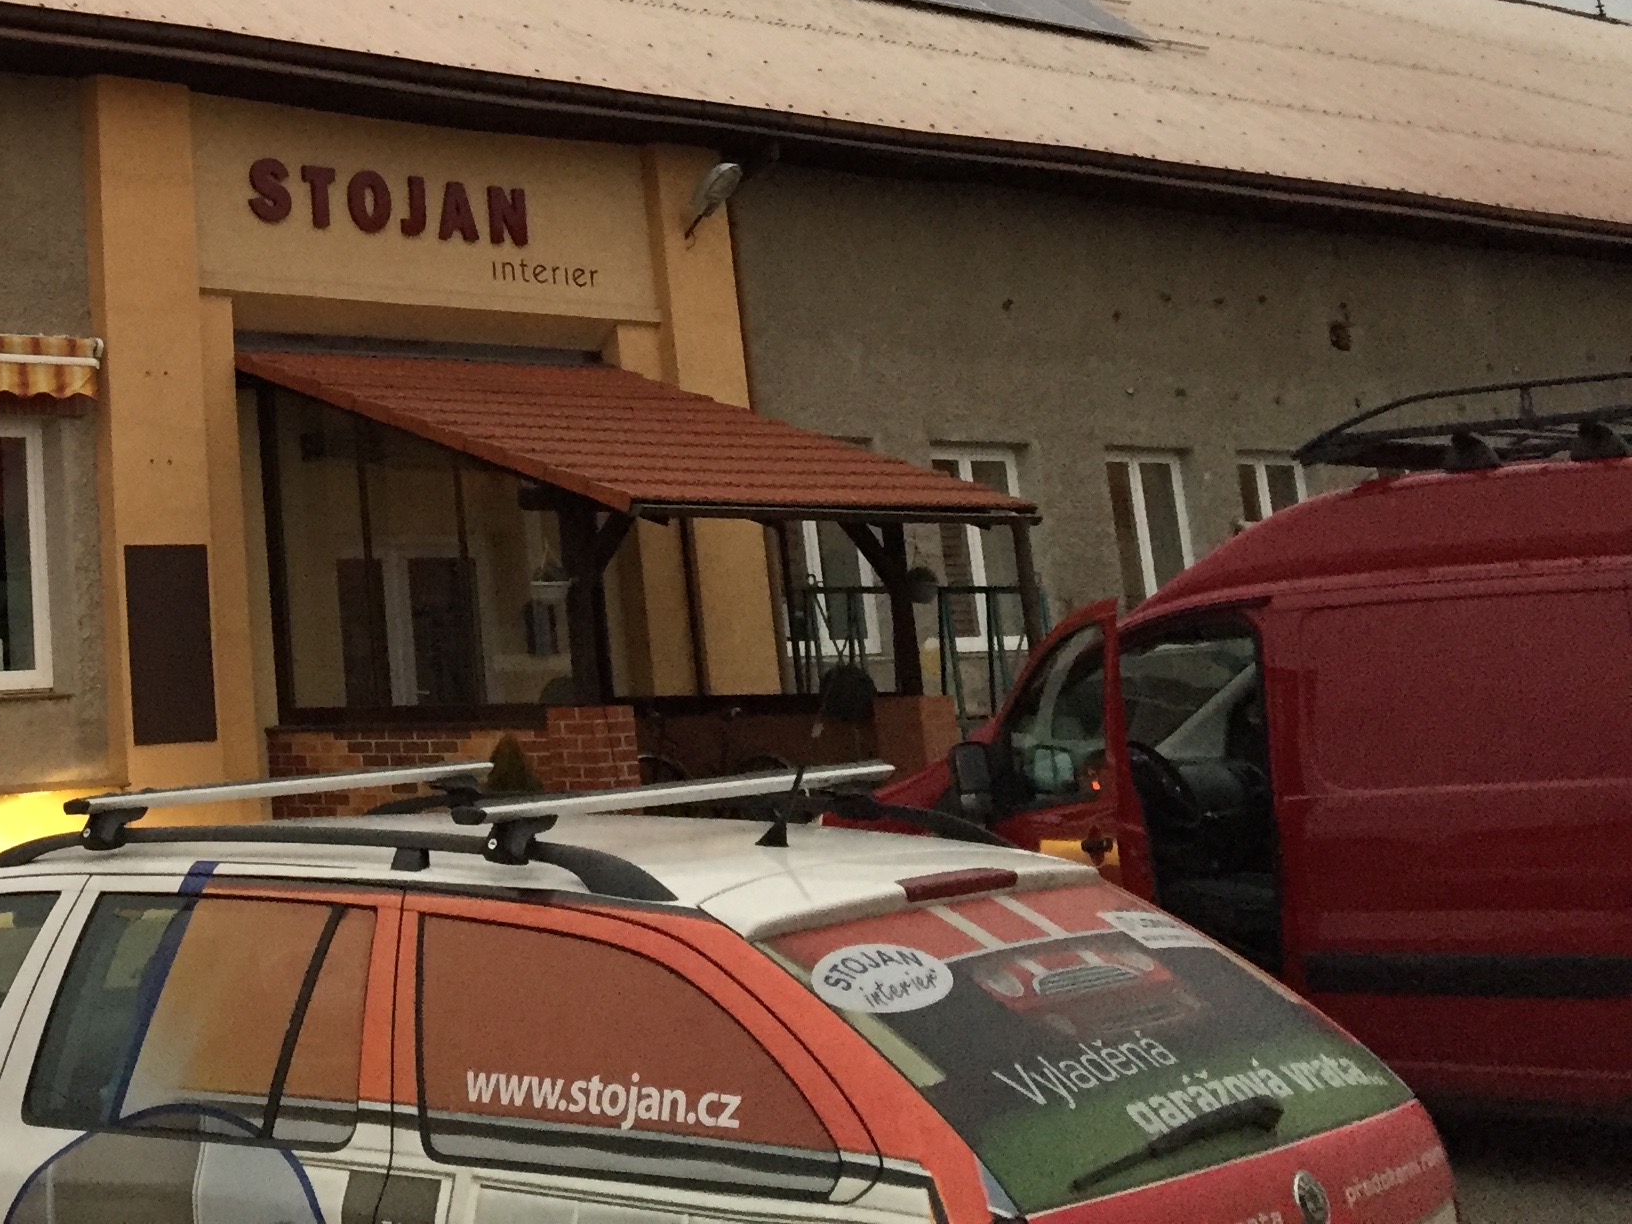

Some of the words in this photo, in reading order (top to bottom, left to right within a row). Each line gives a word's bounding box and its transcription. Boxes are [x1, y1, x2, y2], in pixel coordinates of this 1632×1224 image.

[248, 157, 529, 247] STOJAN
[492, 259, 599, 288] interier
[823, 949, 924, 991] STOJAN
[992, 1030, 1177, 1109] Vyladěná
[466, 1070, 741, 1130] www.stojan.cz
